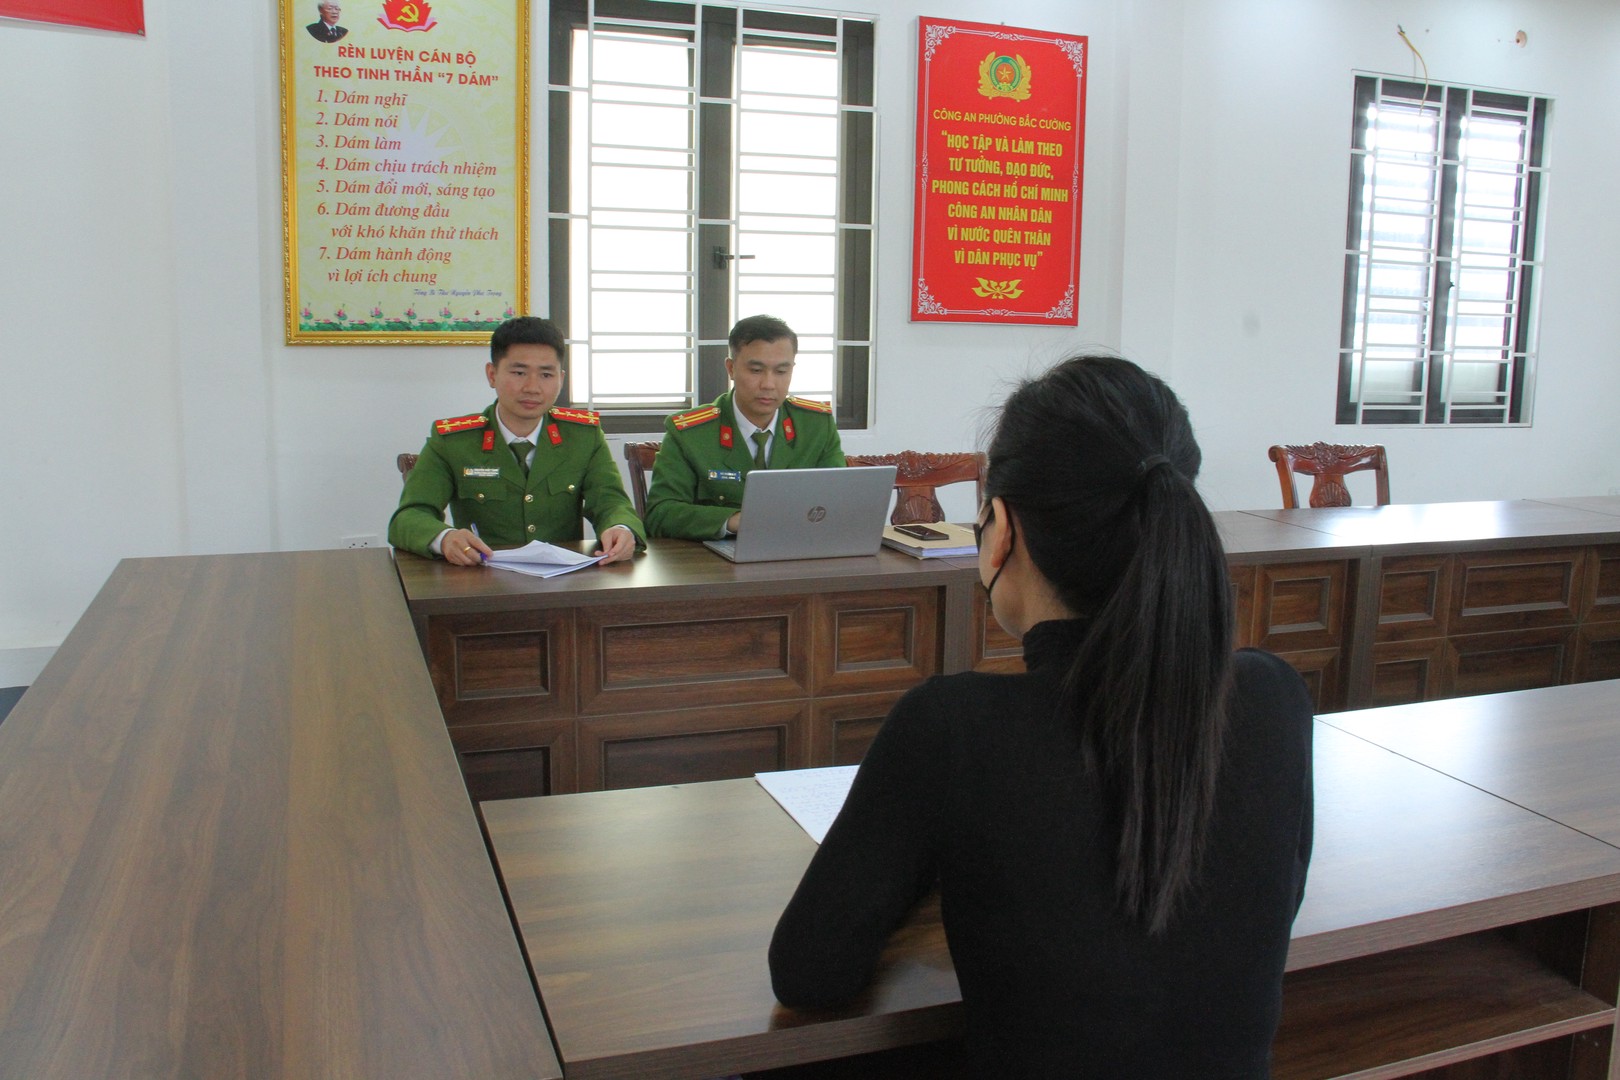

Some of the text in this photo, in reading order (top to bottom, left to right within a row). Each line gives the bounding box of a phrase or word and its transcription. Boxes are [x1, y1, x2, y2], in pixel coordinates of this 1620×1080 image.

[338, 44, 476, 68] RÈN LUYỆN CÁN BỘ
[314, 65, 499, 86] THEO TINH THẦN “7 DÁM”
[316, 89, 408, 109] 1. Dám nghĩ
[315, 111, 399, 128] 2. Dám nói
[933, 107, 1072, 131] CÔNG AN PHƯỜNG BẮC CƯỜNG
[315, 134, 402, 151] 3. Dám làm
[941, 130, 1063, 157] “HỌC TẬP VÀ LÀM THEO
[316, 157, 497, 179] 4. Dám chịu trách nhiệm
[948, 155, 1055, 181] TƯ TƯỞNG, ĐẠO ĐỨC,
[316, 177, 496, 200] 5. Dám đổi mới, sáng tạo
[931, 179, 969, 195] PHONG
[972, 179, 1001, 197] CÁCH
[1020, 184, 1038, 200] CHÍ
[1040, 187, 1069, 202] MINH
[317, 202, 450, 221] 6. Dám đương đầu
[947, 201, 1053, 224] CÔNG AN NHÂN DÂN
[331, 225, 499, 241] với khó khăn thử thách
[947, 224, 1051, 246] VÌ NƯỚC QUÊN THÂN
[319, 246, 452, 265] 7. Dám hành động
[954, 247, 1044, 270] VÌ DÂN PHỤC VỤ”
[327, 269, 438, 286] vì lợi ích chung
[809, 506, 826, 523] hp
